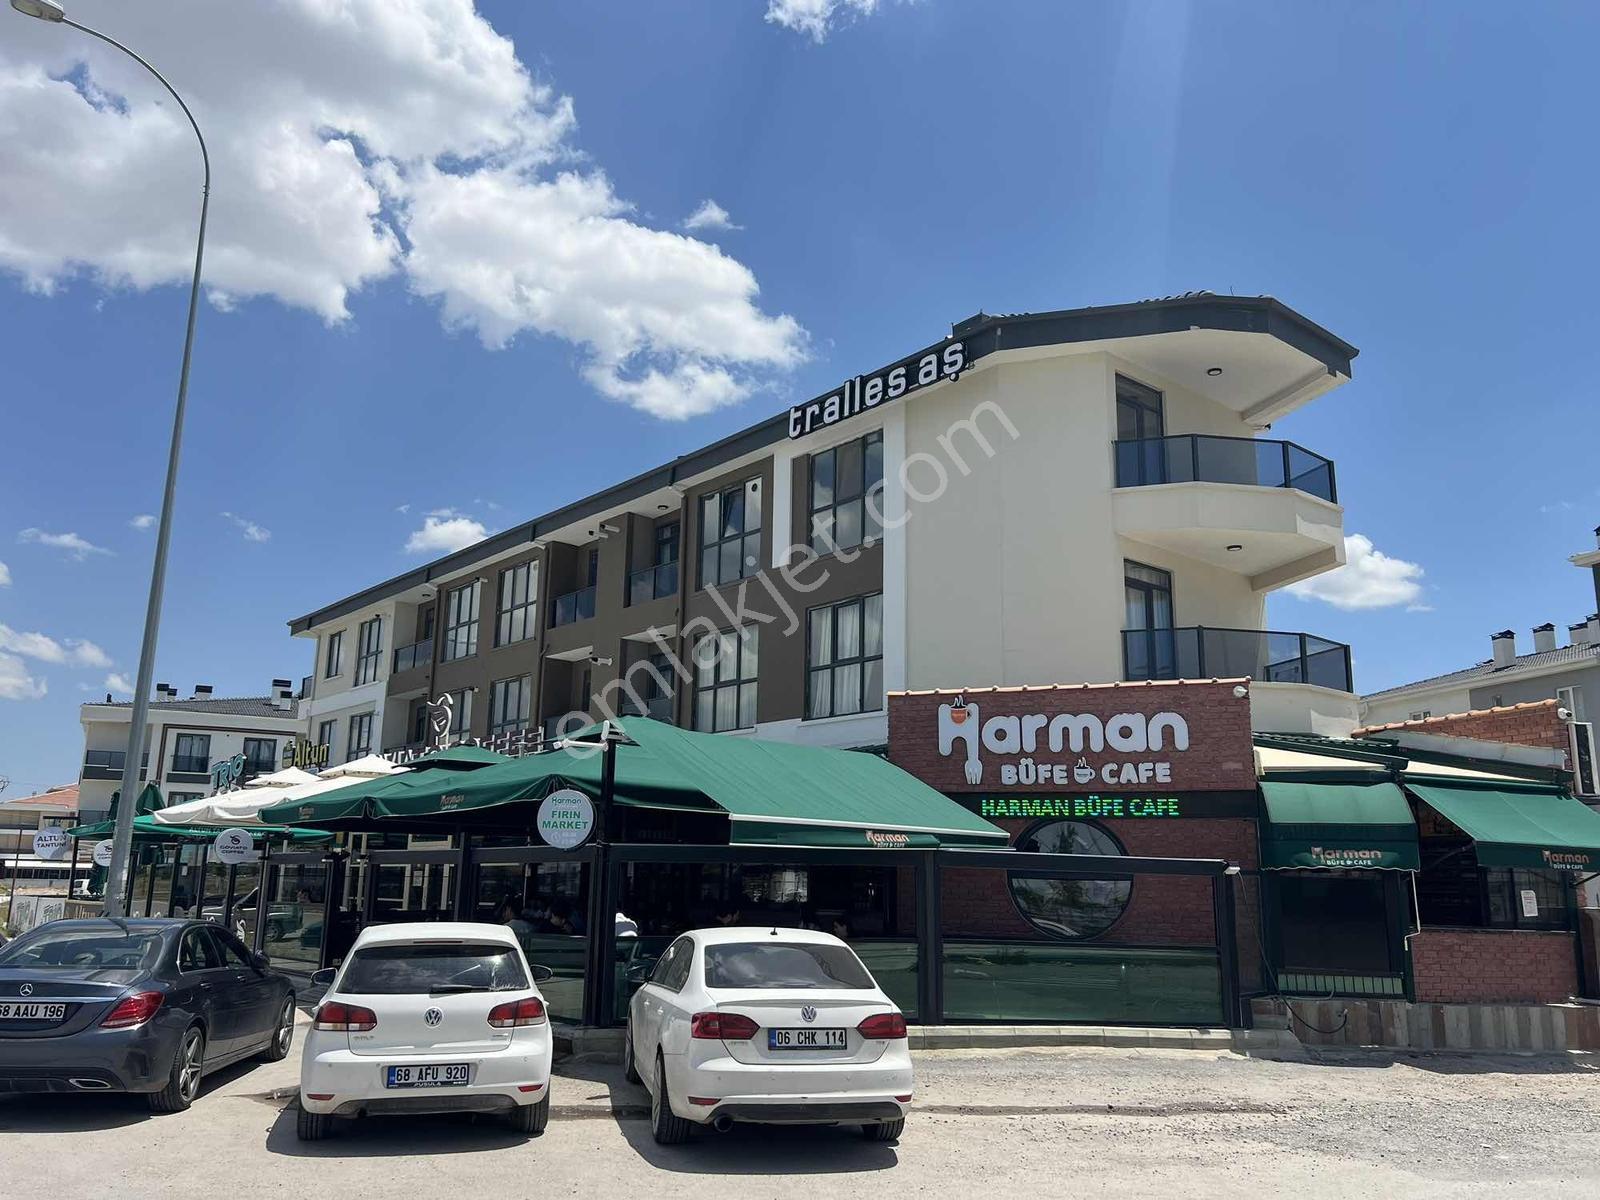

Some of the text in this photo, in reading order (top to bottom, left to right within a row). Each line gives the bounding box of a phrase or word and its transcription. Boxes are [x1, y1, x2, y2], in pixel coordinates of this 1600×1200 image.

[789, 342, 964, 438] tralles aş
[938, 700, 1190, 785] Harman
[294, 740, 329, 768] Altun
[211, 752, 246, 790] TRIO
[1001, 757, 1172, 785] BÜFE CAFE
[551, 796, 582, 806] Harman
[981, 795, 1180, 816] HARMAN BÜFE CAFE
[551, 810, 581, 819] FIRIN
[542, 821, 589, 829] MARKET
[865, 830, 910, 845] Harman
[1311, 847, 1382, 864] Harman
[1542, 850, 1590, 866] Harman
[13, 1005, 40, 1017] AAU
[43, 1005, 64, 1017] 196
[777, 1031, 844, 1045] 06 CHK 114
[396, 1066, 467, 1081] 68 AFU 920
